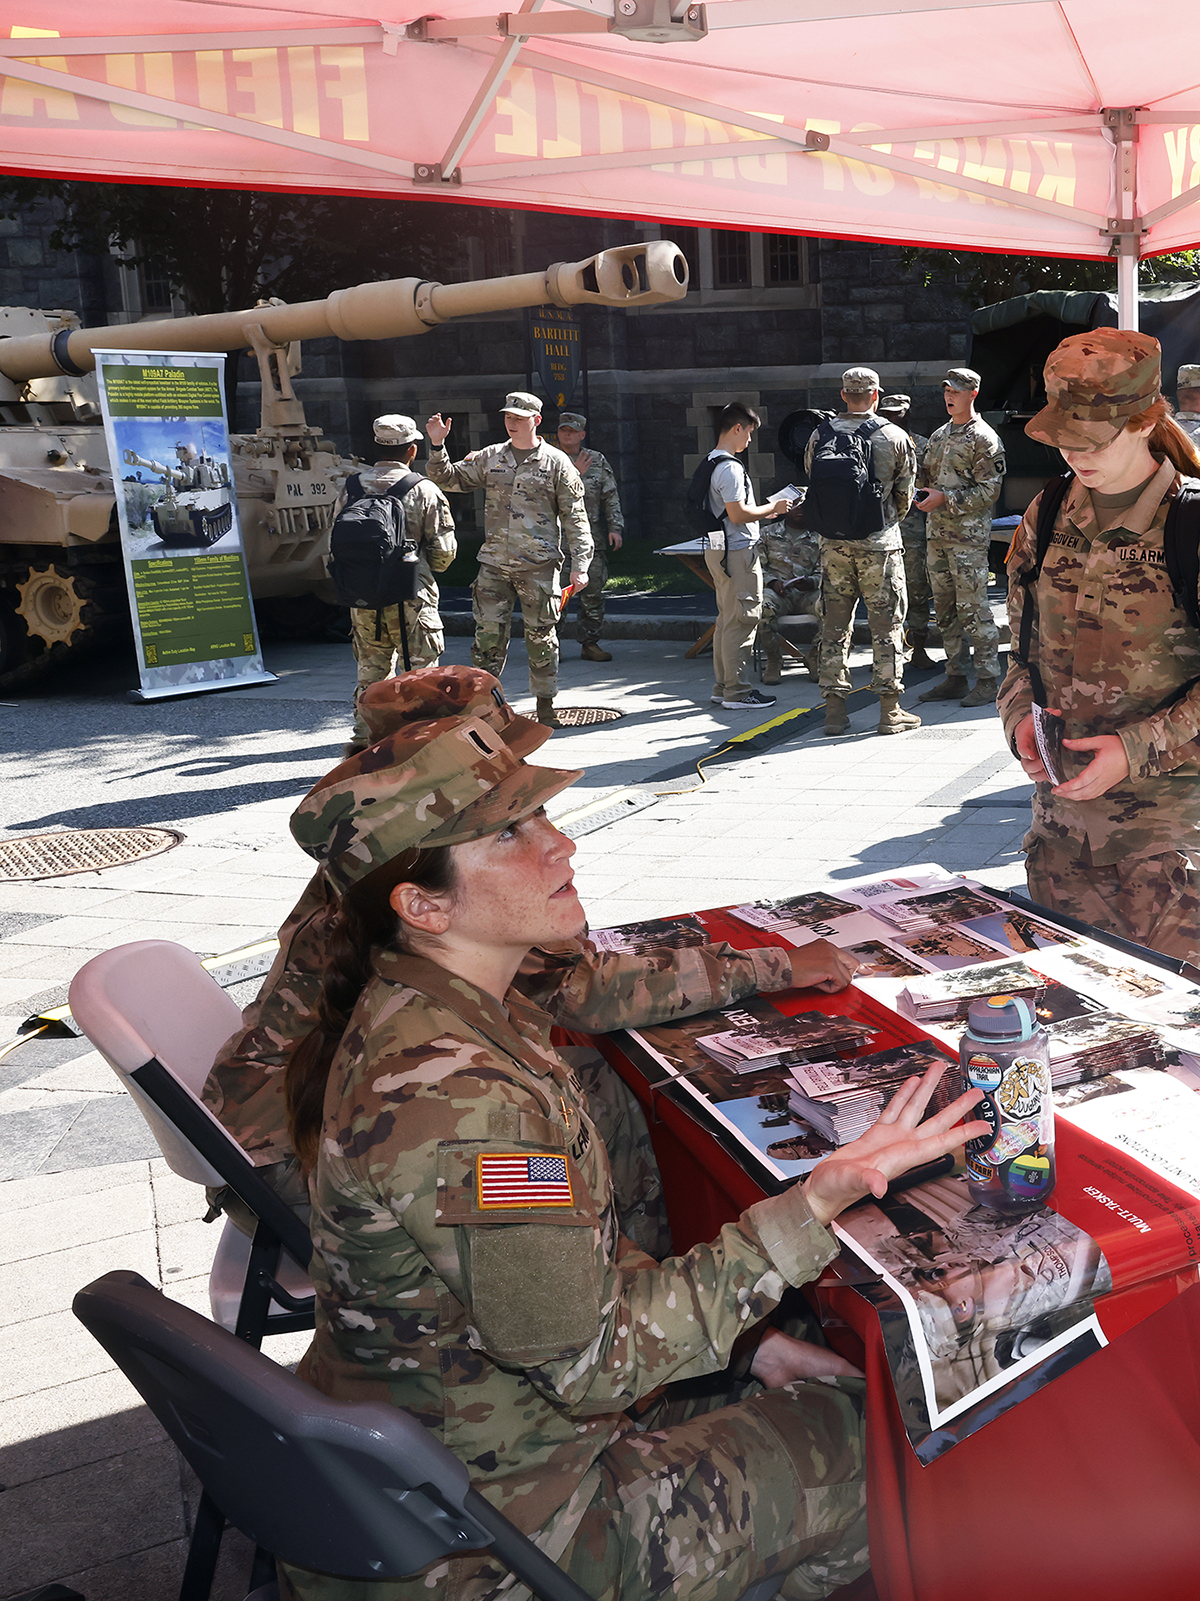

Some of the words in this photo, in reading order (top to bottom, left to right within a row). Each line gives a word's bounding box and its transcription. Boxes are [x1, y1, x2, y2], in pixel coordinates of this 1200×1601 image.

[534, 326, 579, 341] BARTLETT
[545, 344, 570, 356] HALL
[164, 370, 185, 378] Paladin
[286, 484, 304, 496] PAL
[310, 483, 327, 495] 392
[976, 1073, 990, 1082] TRAIL
[975, 1164, 992, 1176] PARK
[1083, 1185, 1152, 1233] MULTI-TASKER
[1167, 1210, 1197, 1257] processes
[1041, 1245, 1066, 1278] THOMPSON
